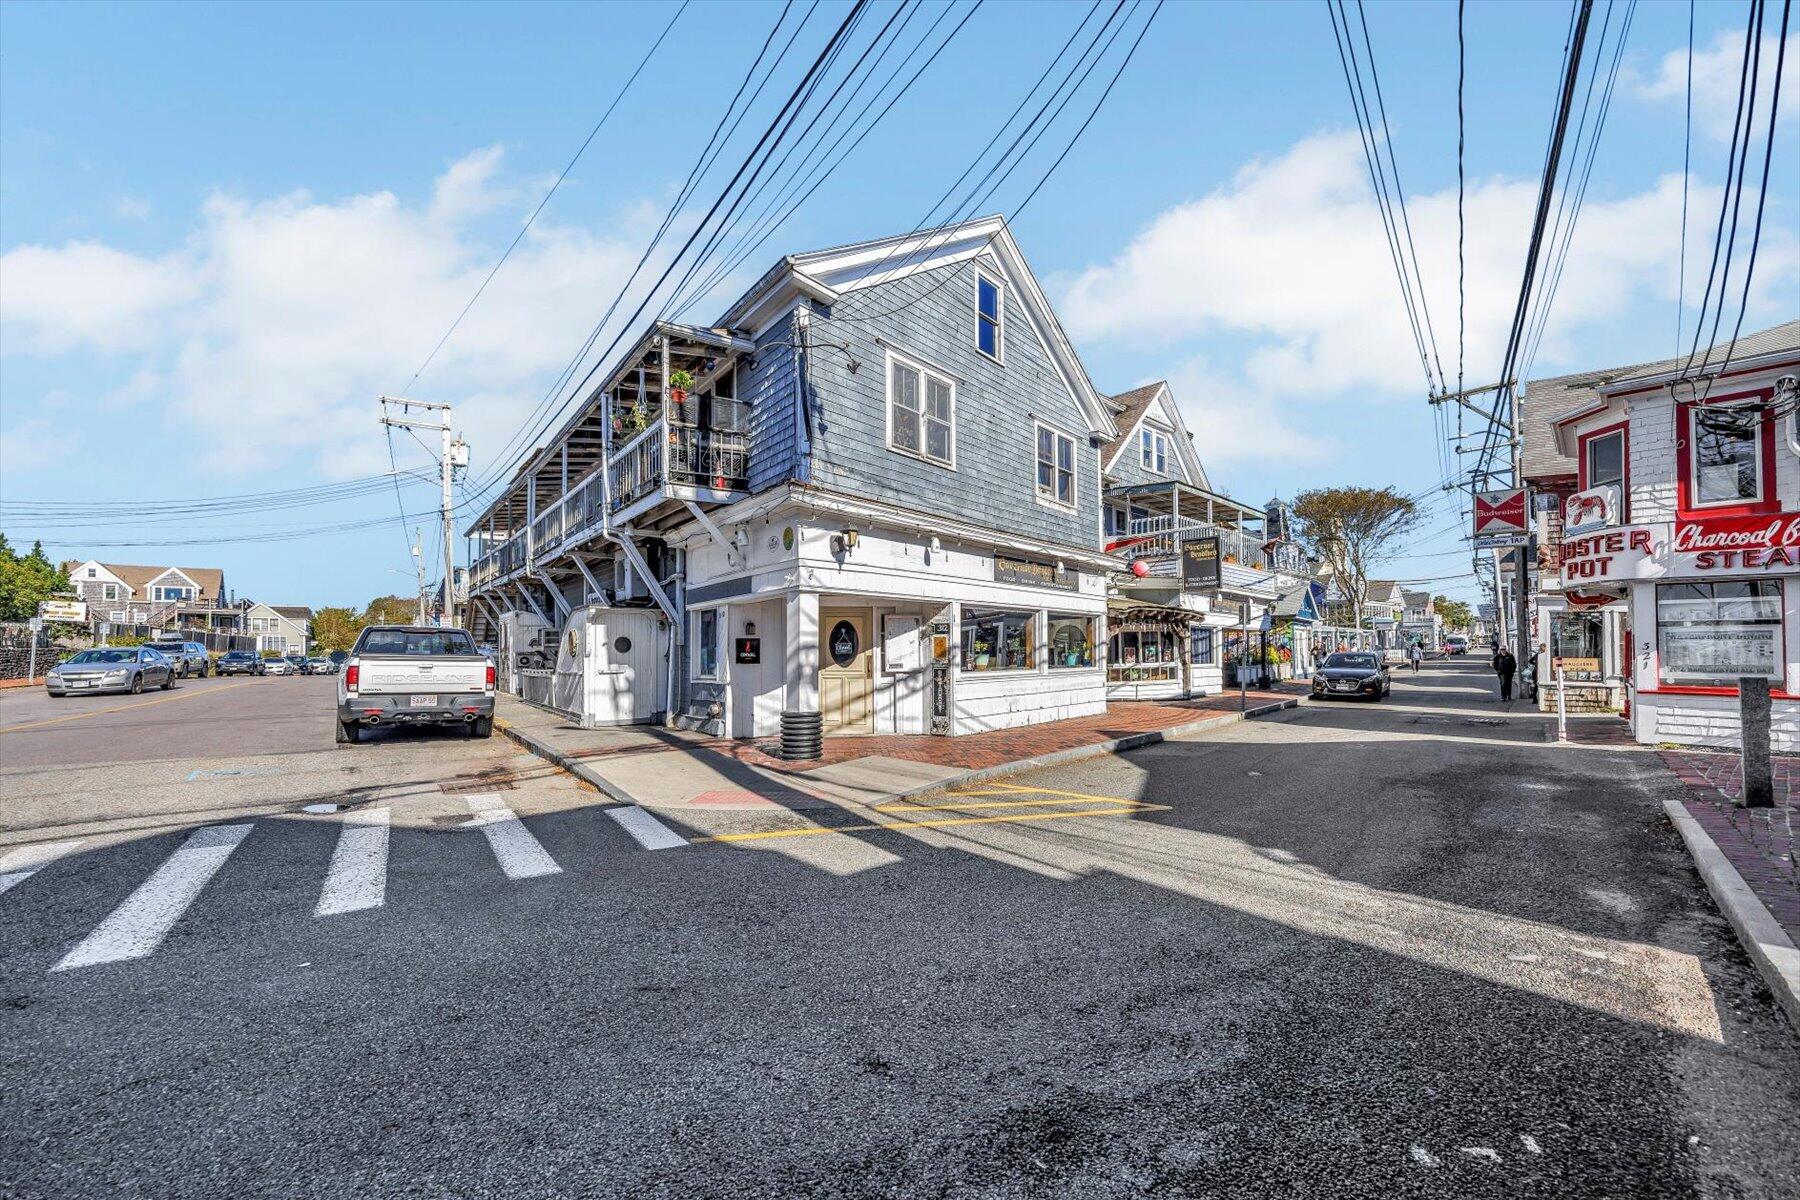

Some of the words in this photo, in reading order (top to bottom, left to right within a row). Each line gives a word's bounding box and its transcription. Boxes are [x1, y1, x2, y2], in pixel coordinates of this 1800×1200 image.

[1477, 508, 1524, 518] Budweiser
[1675, 520, 1782, 551] Charcoal
[1567, 557, 1613, 580] POT
[1695, 548, 1800, 570] STEA
[371, 674, 478, 685] RIDGELINE
